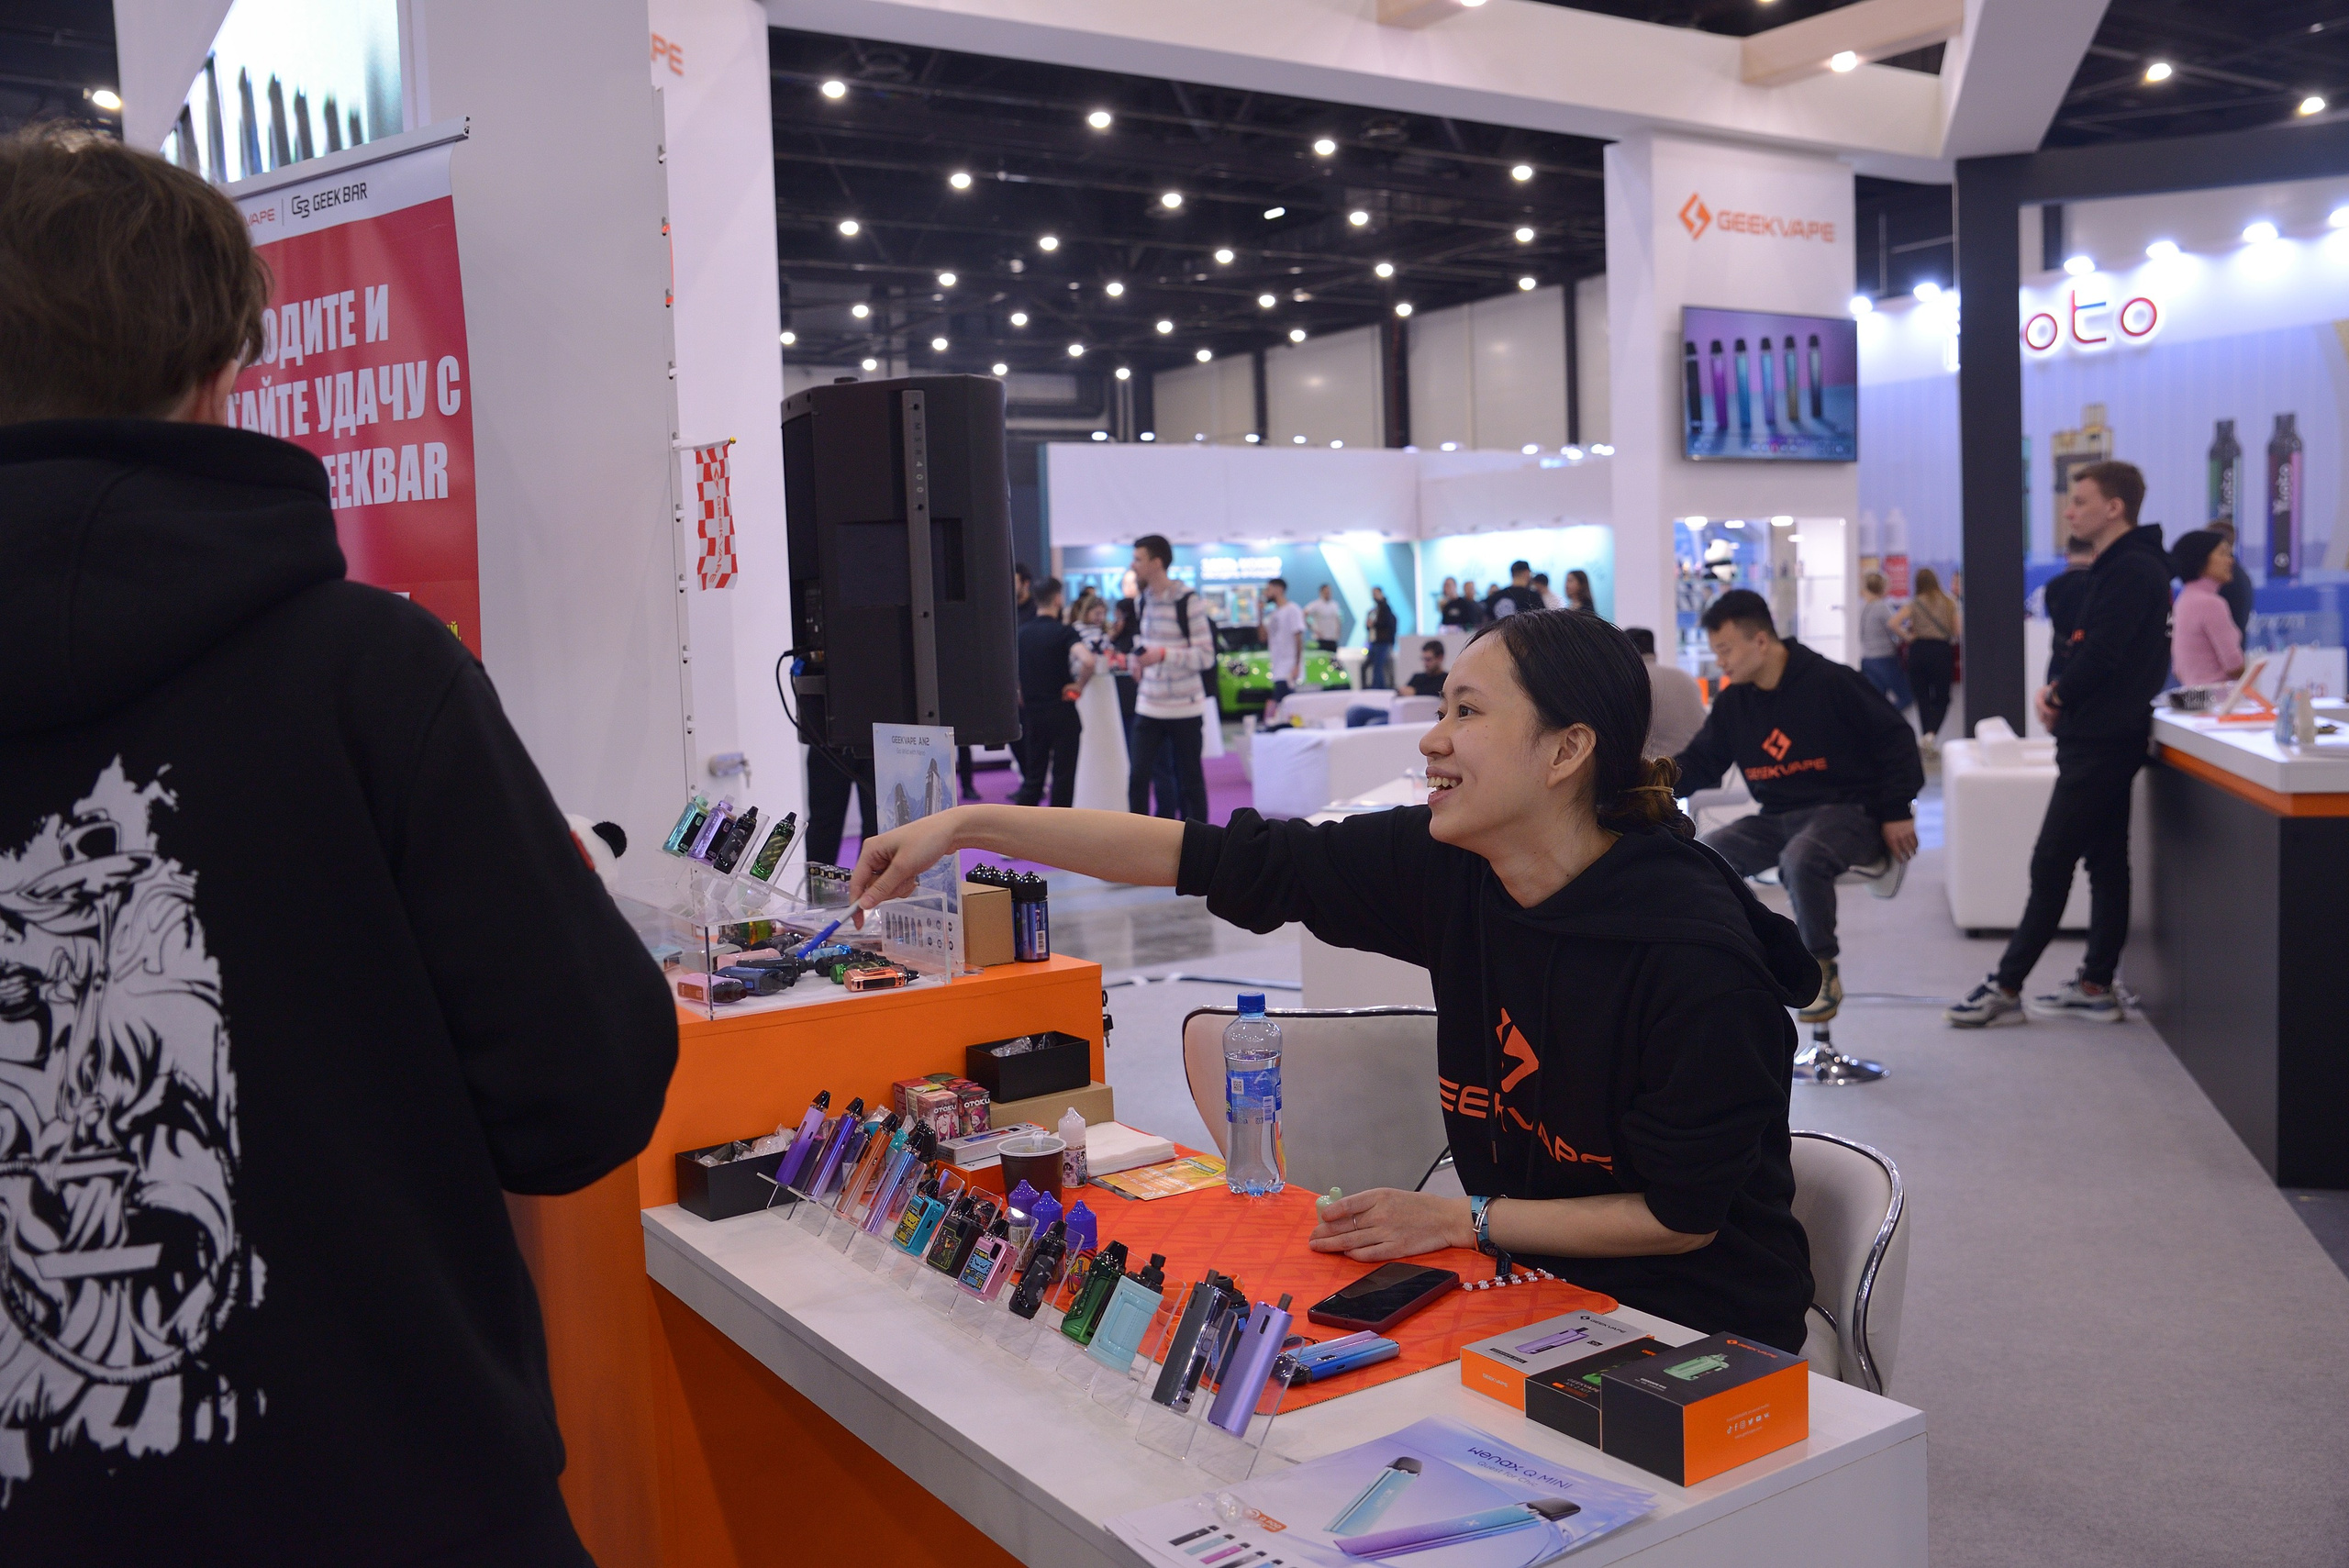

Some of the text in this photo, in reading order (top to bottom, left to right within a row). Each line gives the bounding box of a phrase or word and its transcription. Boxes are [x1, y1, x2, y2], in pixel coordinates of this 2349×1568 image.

[247, 208, 275, 227] VAPE
[313, 188, 341, 211] GEEK
[342, 183, 368, 203] BAR
[1717, 209, 1836, 243] GEEKVAPE
[250, 284, 388, 369] ОДИТЕ И
[2025, 289, 2158, 350] oto
[227, 375, 309, 439] ТАЙТЕ
[315, 360, 428, 439] УДАЧУ
[322, 441, 449, 510] EEKBAR
[891, 735, 930, 746] GEEKVAPE AN2
[933, 1104, 957, 1114] OTOKU
[964, 1097, 991, 1109] OTOKU
[1589, 1318, 1627, 1334] GEEKVAPE
[1737, 1342, 1778, 1359] GEEKVAPE
[1477, 1461, 1539, 1487] Quest for Chic
[1523, 1469, 1537, 1477] Q
[1539, 1474, 1574, 1490] MINI
